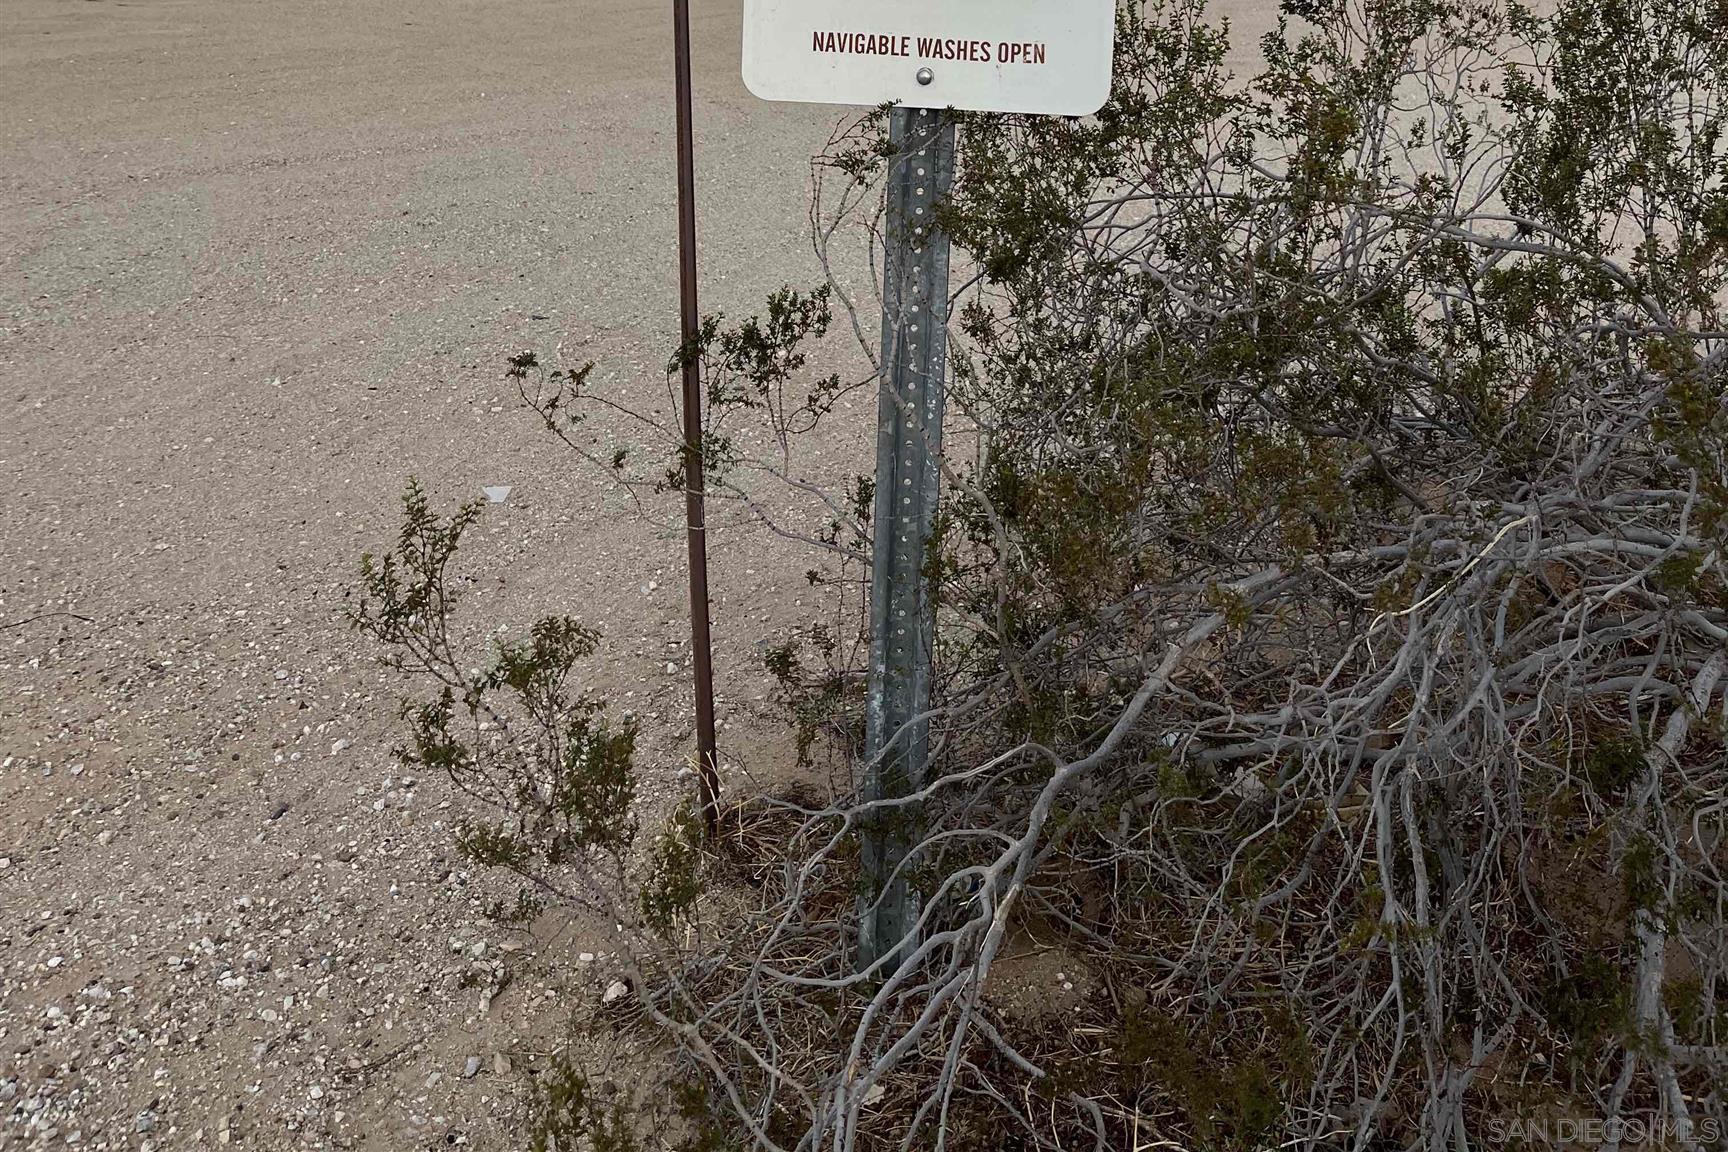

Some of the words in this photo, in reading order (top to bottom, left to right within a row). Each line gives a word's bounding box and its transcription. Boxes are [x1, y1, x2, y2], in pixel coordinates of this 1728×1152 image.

[813, 31, 910, 57] NAVIGABLE
[917, 38, 991, 62] WASHES
[998, 42, 1045, 64] OPEN
